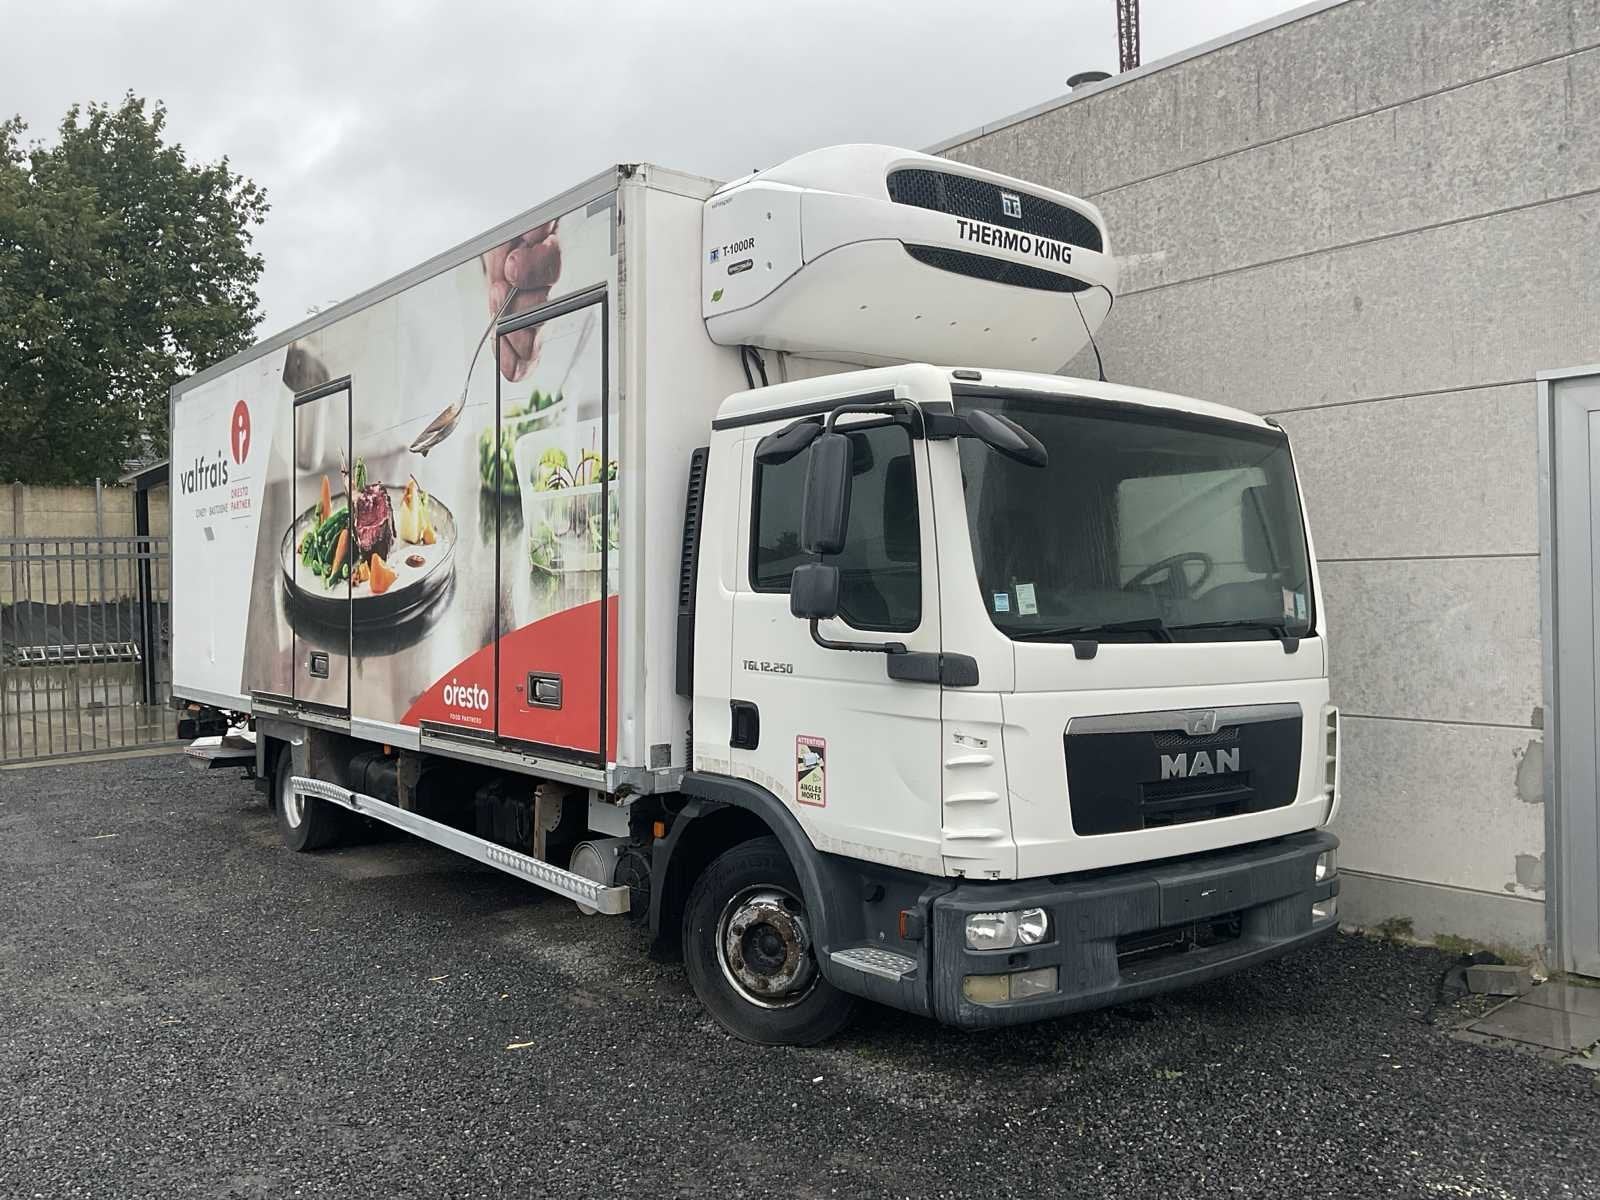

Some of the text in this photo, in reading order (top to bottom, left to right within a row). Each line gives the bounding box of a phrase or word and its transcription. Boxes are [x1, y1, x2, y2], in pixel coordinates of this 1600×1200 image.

[722, 237, 755, 257] T-1000R
[957, 219, 1072, 264] THERMO KING
[180, 450, 228, 495] valfrais
[230, 498, 251, 511] PARTNER
[461, 714, 482, 724] PARTNERS
[1160, 747, 1240, 780] MAN
[800, 783, 822, 794] ANGLES
[801, 790, 821, 801] MORTS
